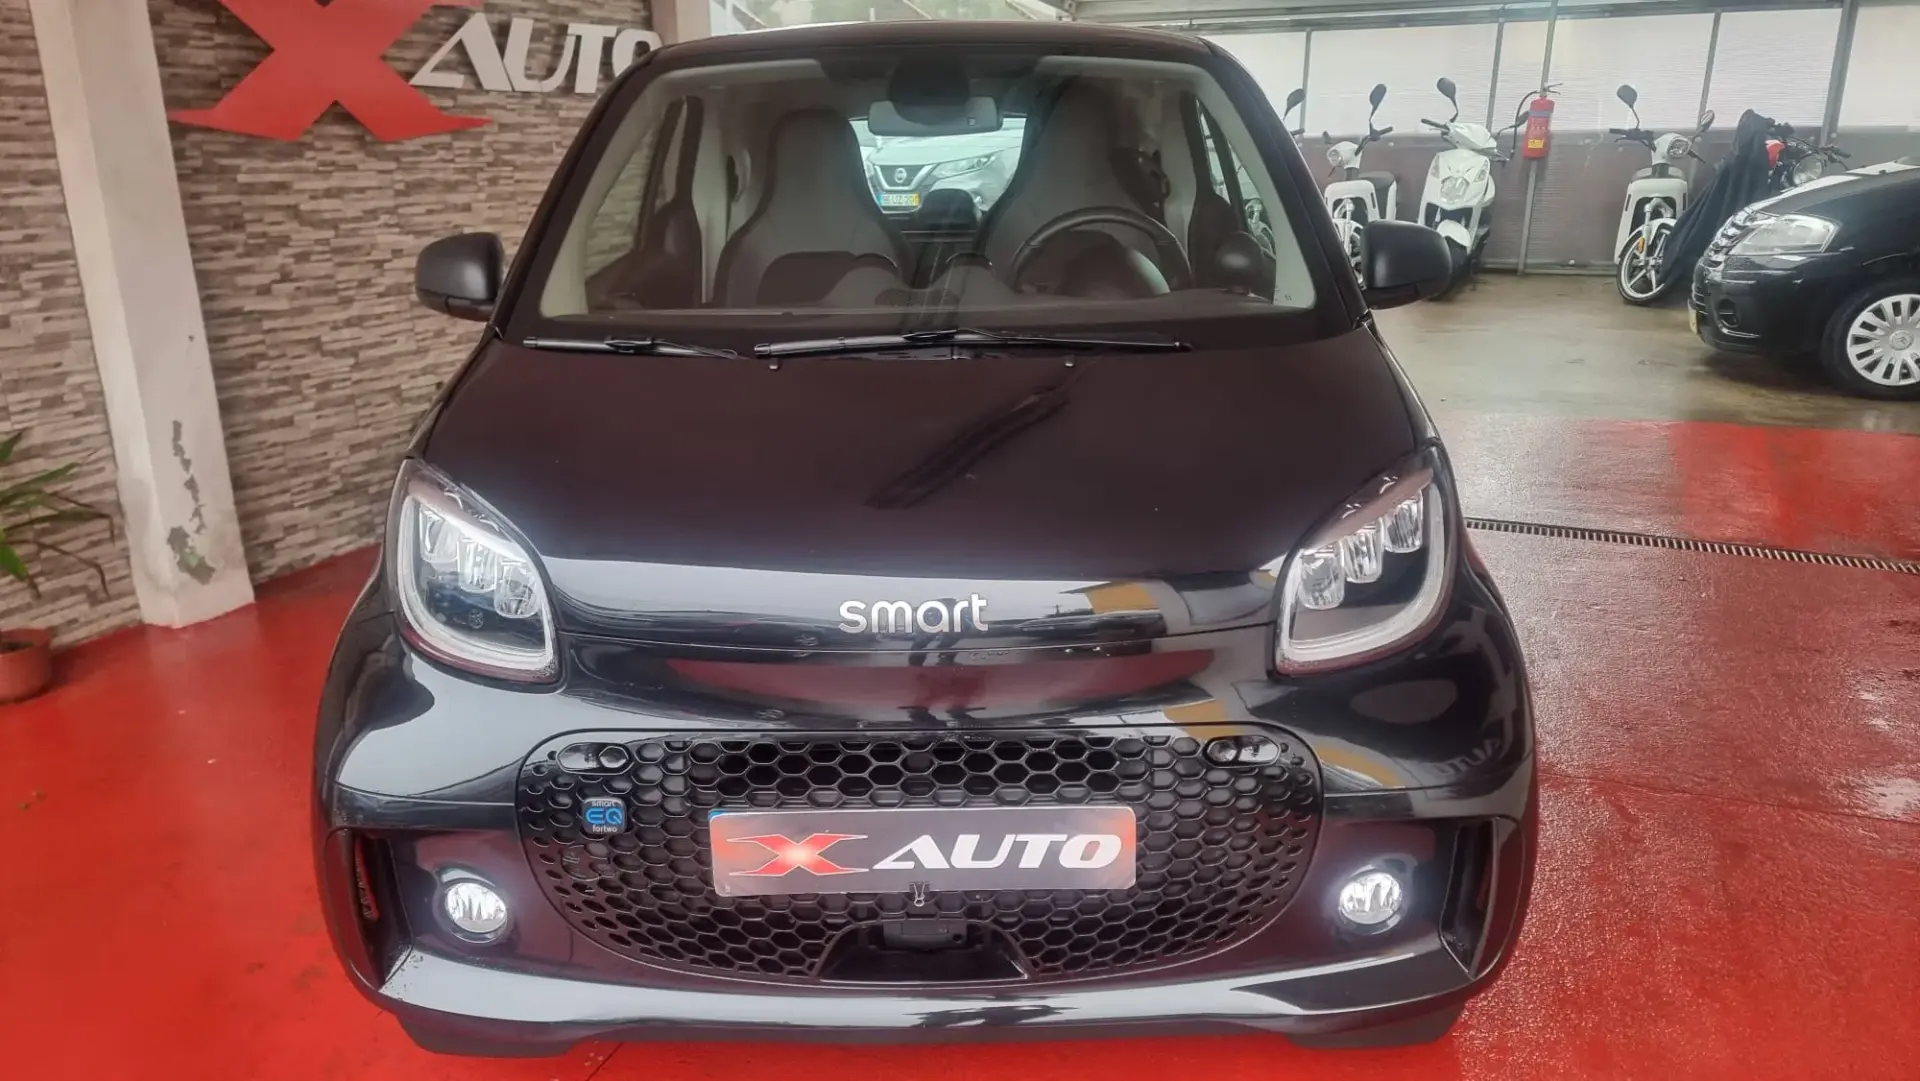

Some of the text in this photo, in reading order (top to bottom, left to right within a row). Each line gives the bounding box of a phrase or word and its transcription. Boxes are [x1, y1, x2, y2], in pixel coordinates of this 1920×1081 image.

[838, 593, 989, 634] smart
[585, 807, 623, 825] EQ
[592, 824, 618, 834] fortwo
[726, 833, 1123, 877] X AUTO
